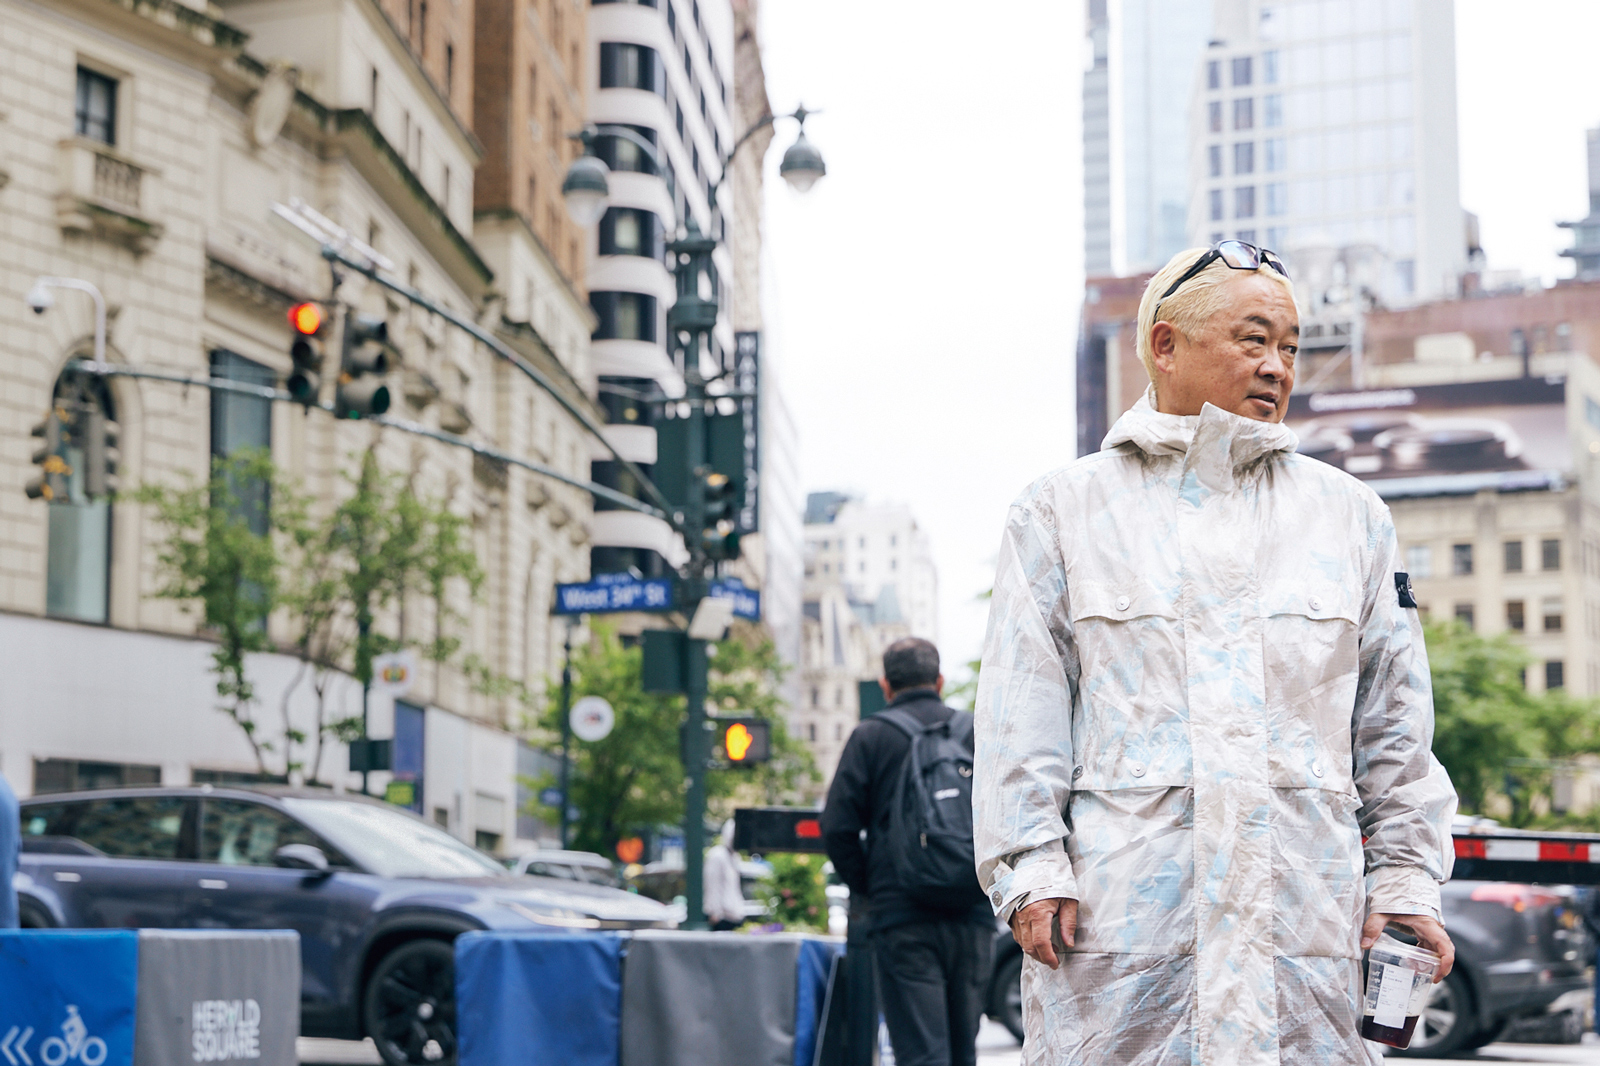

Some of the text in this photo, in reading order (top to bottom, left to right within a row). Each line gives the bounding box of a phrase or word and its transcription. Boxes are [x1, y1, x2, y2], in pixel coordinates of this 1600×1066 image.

[562, 580, 666, 611] West 34th St
[192, 1029, 261, 1062] SQUARE
